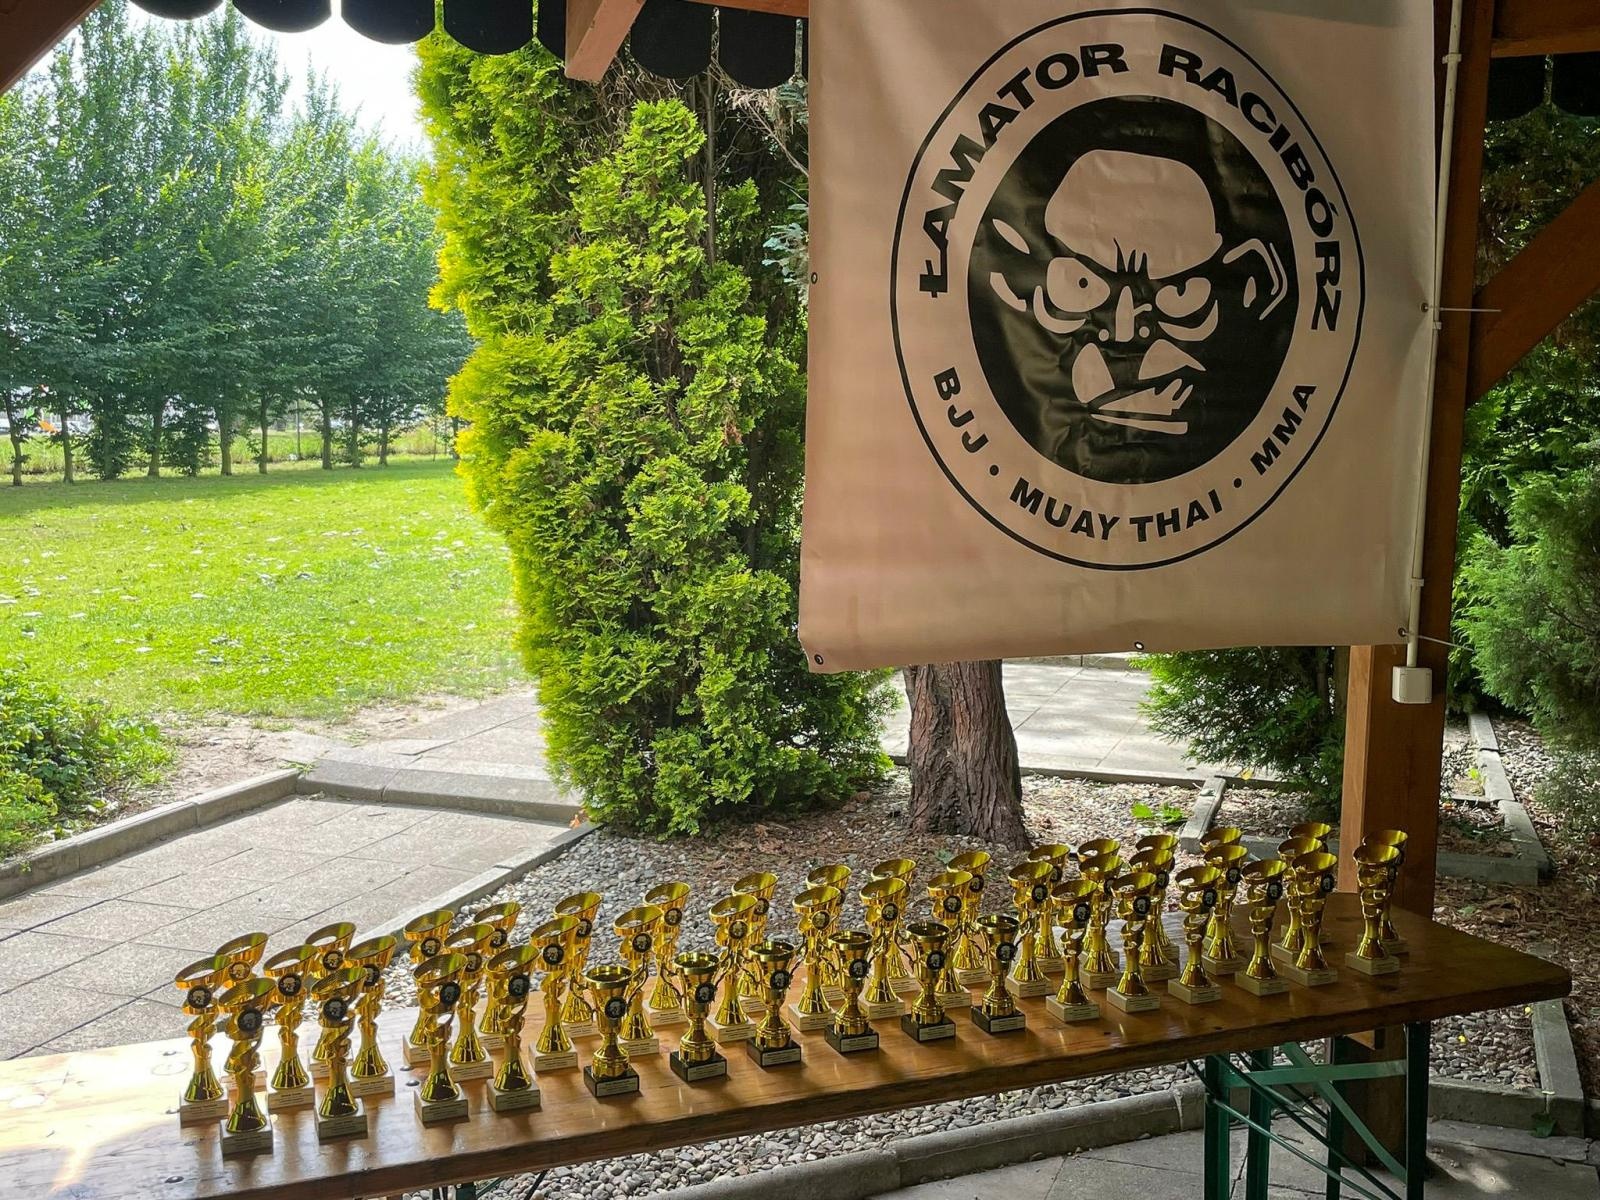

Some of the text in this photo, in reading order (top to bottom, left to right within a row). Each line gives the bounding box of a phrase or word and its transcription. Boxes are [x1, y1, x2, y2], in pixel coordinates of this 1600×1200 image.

[919, 43, 1342, 332] ŁAMATOR RACIBÓRZ
[933, 367, 1317, 543] BJJ MUAY THAI MMA
